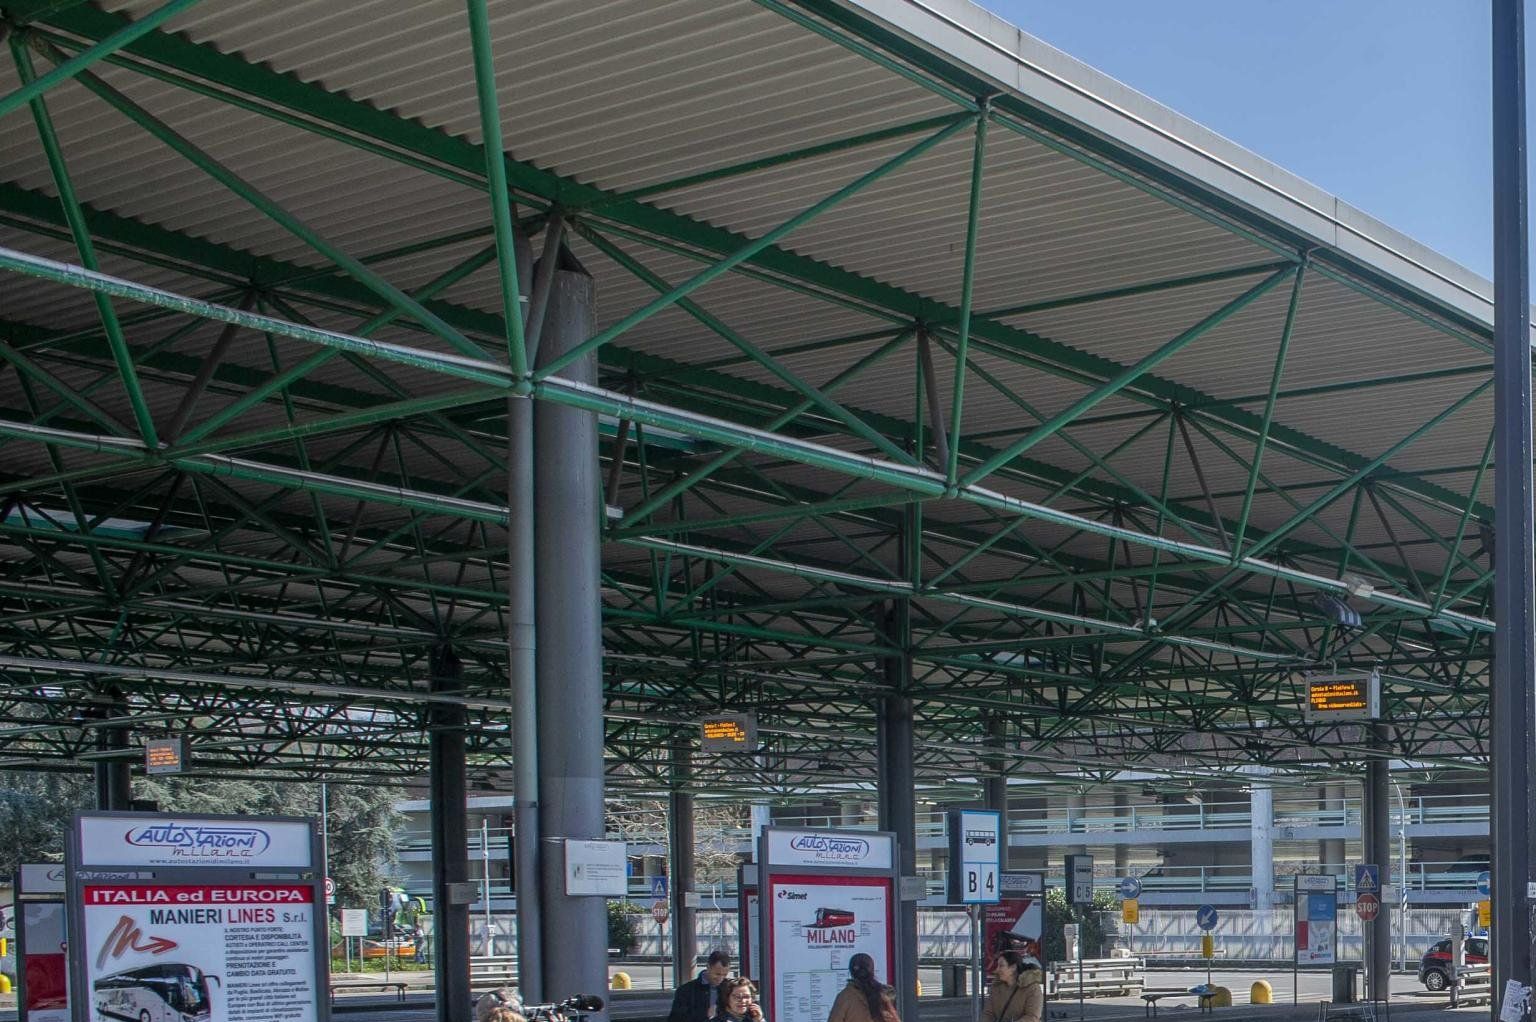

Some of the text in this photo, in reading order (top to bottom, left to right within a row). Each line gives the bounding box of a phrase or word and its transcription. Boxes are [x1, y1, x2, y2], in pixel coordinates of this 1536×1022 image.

[969, 871, 977, 892] B
[986, 871, 994, 892] 4
[92, 889, 304, 903] ITALIA ed EUROPA
[1076, 886, 1082, 898] C
[653, 908, 667, 917] STOP
[1357, 902, 1378, 913] STOP
[151, 908, 222, 925] MANIERI
[228, 908, 275, 924] LINES
[807, 929, 855, 944] MILANO
